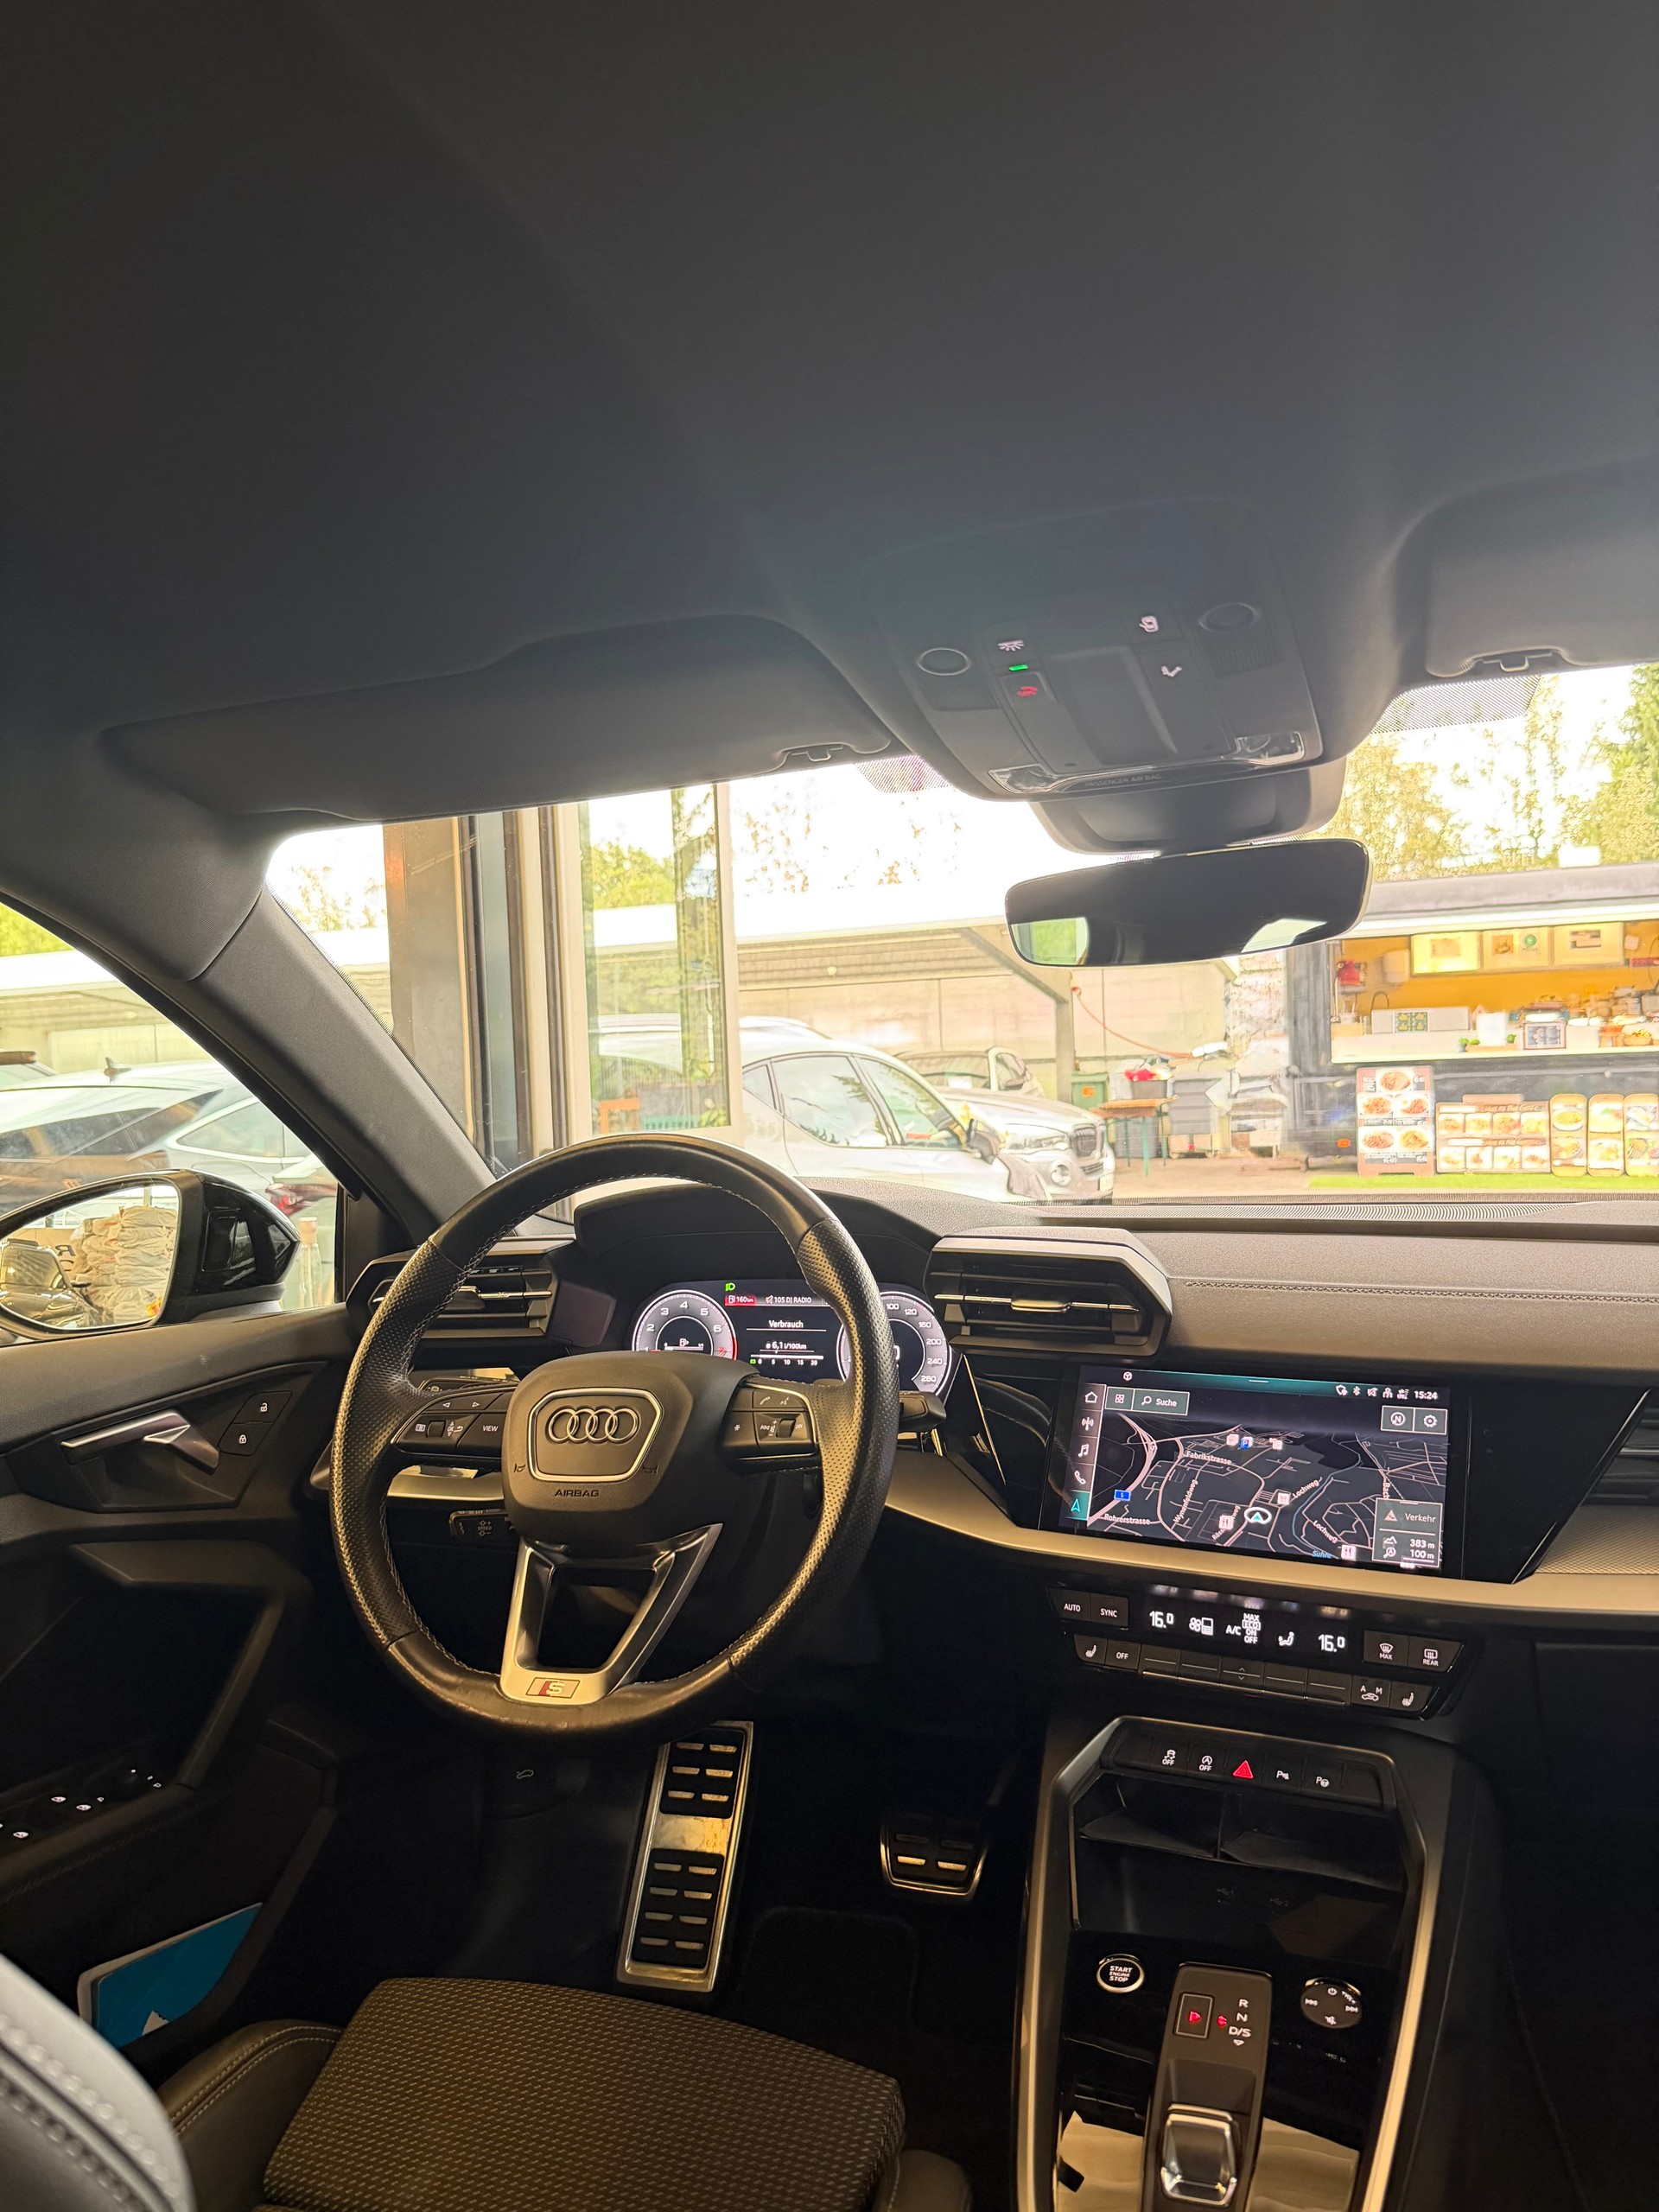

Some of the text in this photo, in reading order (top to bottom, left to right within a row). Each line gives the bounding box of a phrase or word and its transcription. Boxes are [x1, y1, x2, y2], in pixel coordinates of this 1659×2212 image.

[768, 1319, 804, 1328] Verbrauch
[772, 1341, 783, 1350] 6,1
[1414, 1390, 1439, 1400] 15:24
[1155, 1398, 1178, 1408] Suche
[1185, 1451, 1232, 1465] Fabrikstrasse
[554, 1489, 600, 1497] AIRBAG
[1292, 1479, 1320, 1499] Lochweg
[1173, 1478, 1198, 1522] Wynenfeldweg
[1103, 1513, 1151, 1525] Rohrerstrasse
[1405, 1513, 1436, 1522] Verkehr
[1313, 1520, 1338, 1543] Lochweg
[1409, 1539, 1427, 1548] 383
[1313, 1550, 1332, 1559] Suhre
[1409, 1549, 1427, 1558] 100
[1064, 1603, 1081, 1612] AUTO
[1100, 1608, 1118, 1618] SYNC
[1243, 1612, 1260, 1622] MAX
[1225, 1624, 1242, 1636] A/C
[1243, 1636, 1258, 1644] OFF
[1116, 1651, 1128, 1660] OFF
[1422, 1658, 1439, 1667] REAR
[1238, 1999, 1249, 2008] R
[1236, 2012, 1249, 2023] N
[1228, 2025, 1252, 2037] D/S
